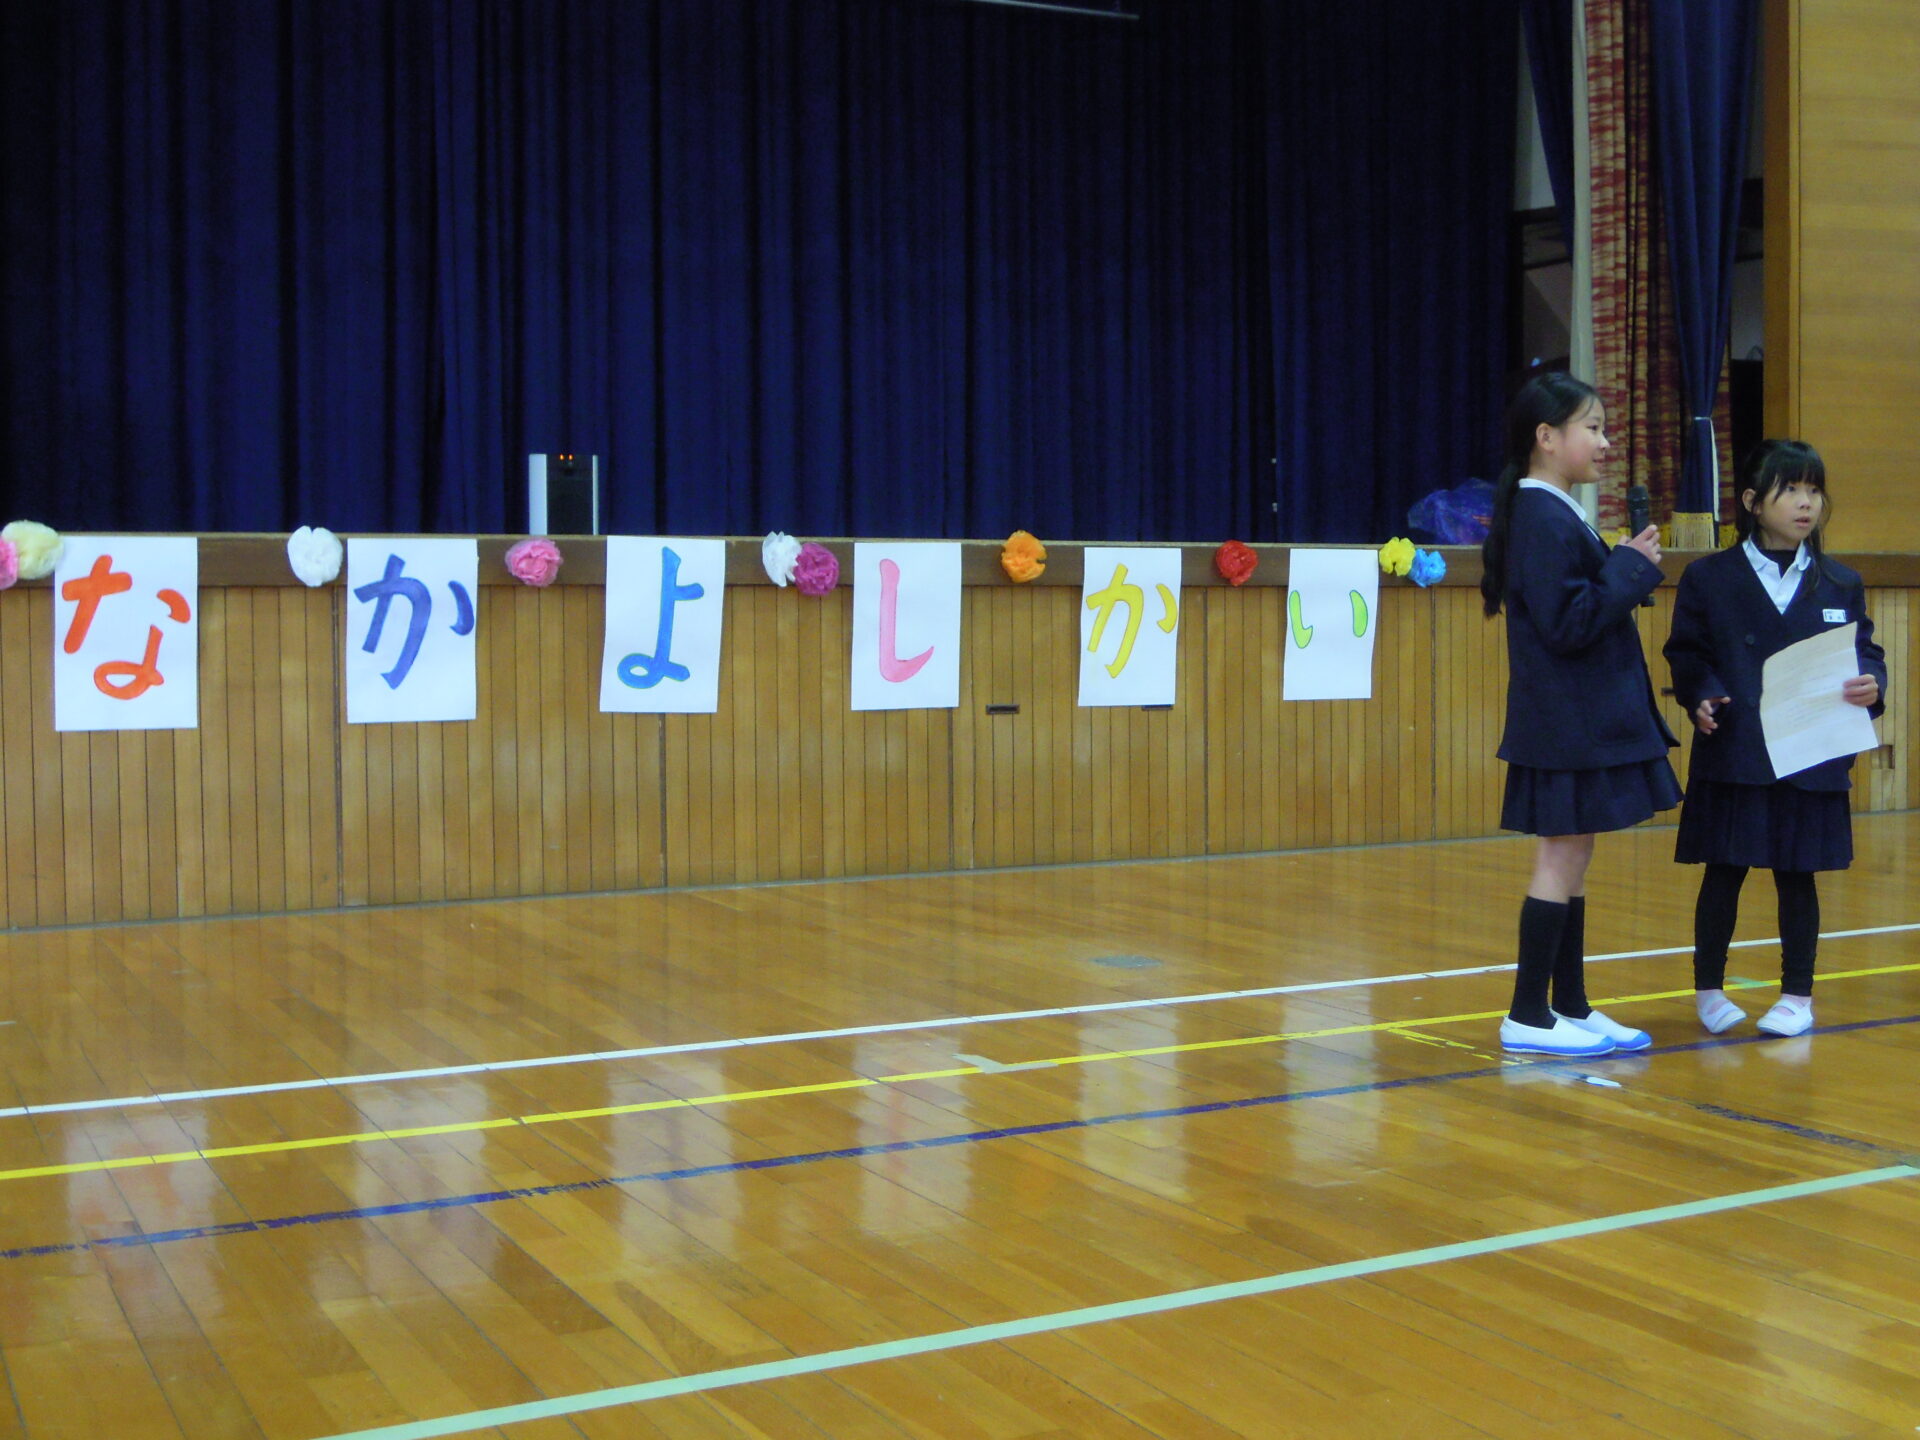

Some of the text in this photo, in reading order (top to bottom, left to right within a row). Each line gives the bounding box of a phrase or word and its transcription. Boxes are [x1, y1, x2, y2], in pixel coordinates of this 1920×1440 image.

[62, 545, 1369, 700] な か よ し か い
